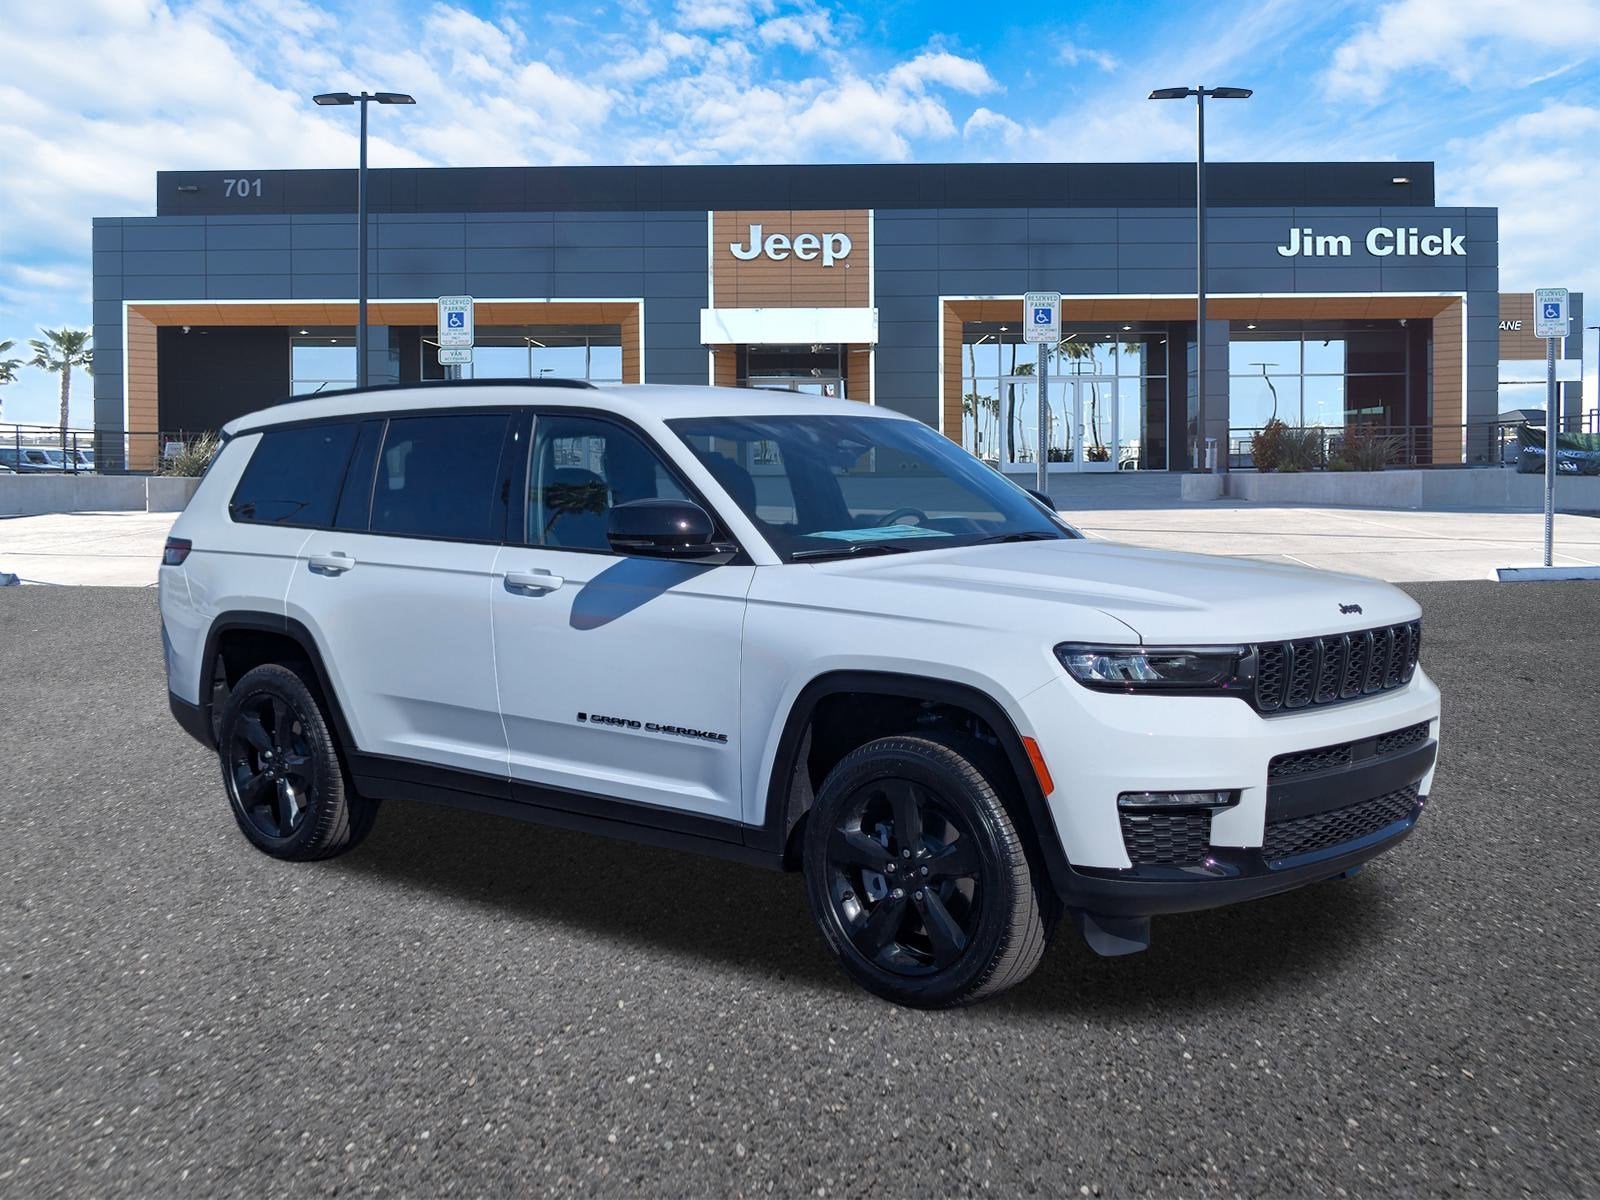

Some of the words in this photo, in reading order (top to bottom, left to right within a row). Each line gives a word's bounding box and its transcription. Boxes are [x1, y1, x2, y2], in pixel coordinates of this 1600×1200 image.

[223, 178, 262, 198] 701
[729, 223, 852, 267] Jeep
[1277, 227, 1352, 257] Jim
[1365, 227, 1467, 257] Click
[589, 713, 643, 730] GRAND
[644, 721, 729, 745] CHEROKEE
